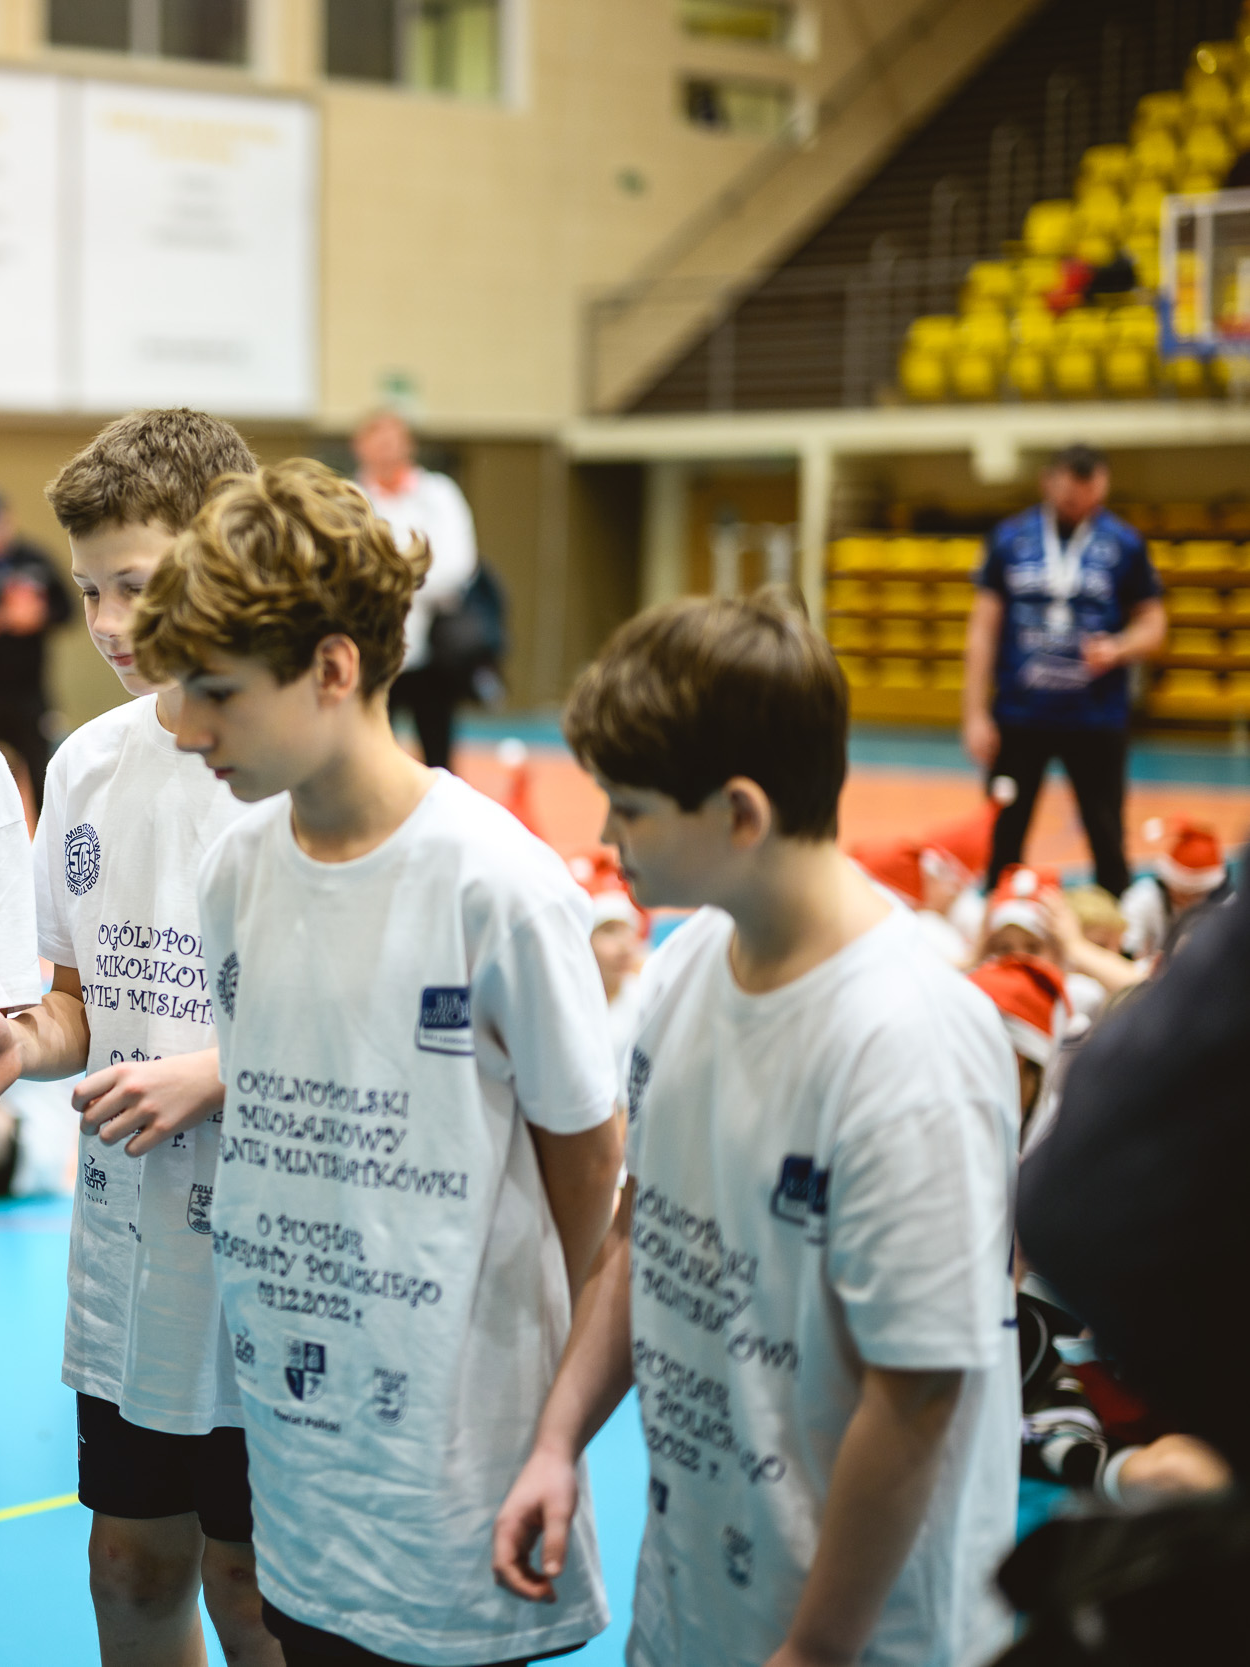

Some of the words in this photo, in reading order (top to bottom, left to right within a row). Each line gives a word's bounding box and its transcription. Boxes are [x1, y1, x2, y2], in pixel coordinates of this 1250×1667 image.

[237, 1068, 410, 1119] OGÓLNOPOLSKI
[238, 1103, 407, 1154] MIKOŁAJKOWY
[192, 1183, 214, 1194] POLI
[257, 1212, 271, 1237] O
